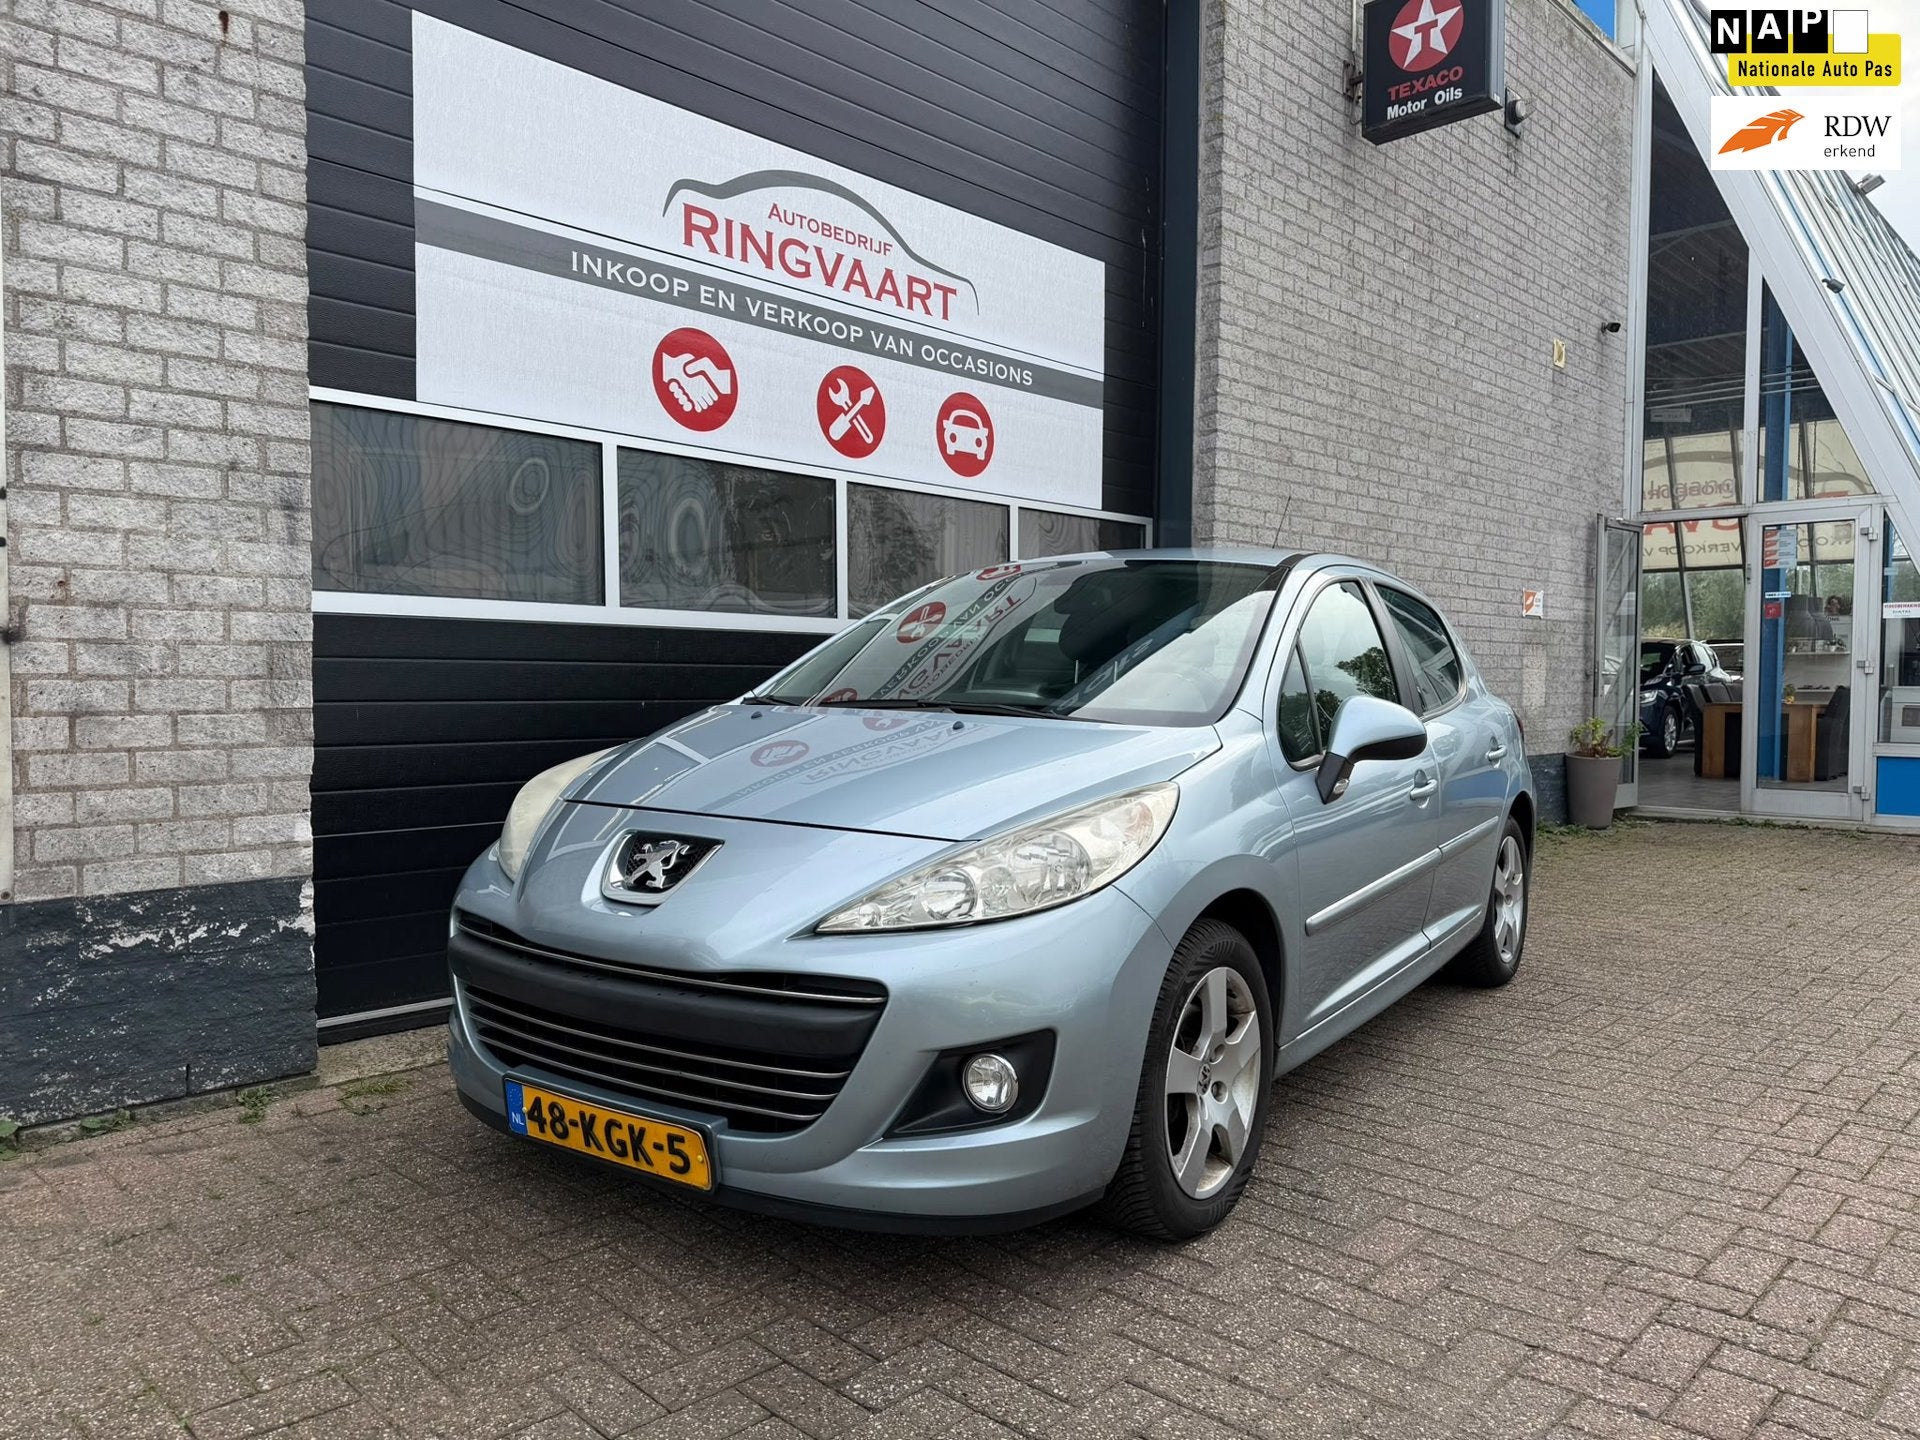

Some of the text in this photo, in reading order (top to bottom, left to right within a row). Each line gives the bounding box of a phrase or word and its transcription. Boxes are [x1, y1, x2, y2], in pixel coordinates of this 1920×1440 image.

[1386, 87, 1463, 120] Motor Oils
[1387, 66, 1464, 101] TEXACO
[682, 203, 957, 321] RINGVAART
[571, 250, 1033, 386] INKOOP EN VERKOOP VAN OCCASIONS
[511, 1111, 525, 1126] NL
[527, 1096, 691, 1175] 48-KGK-5
